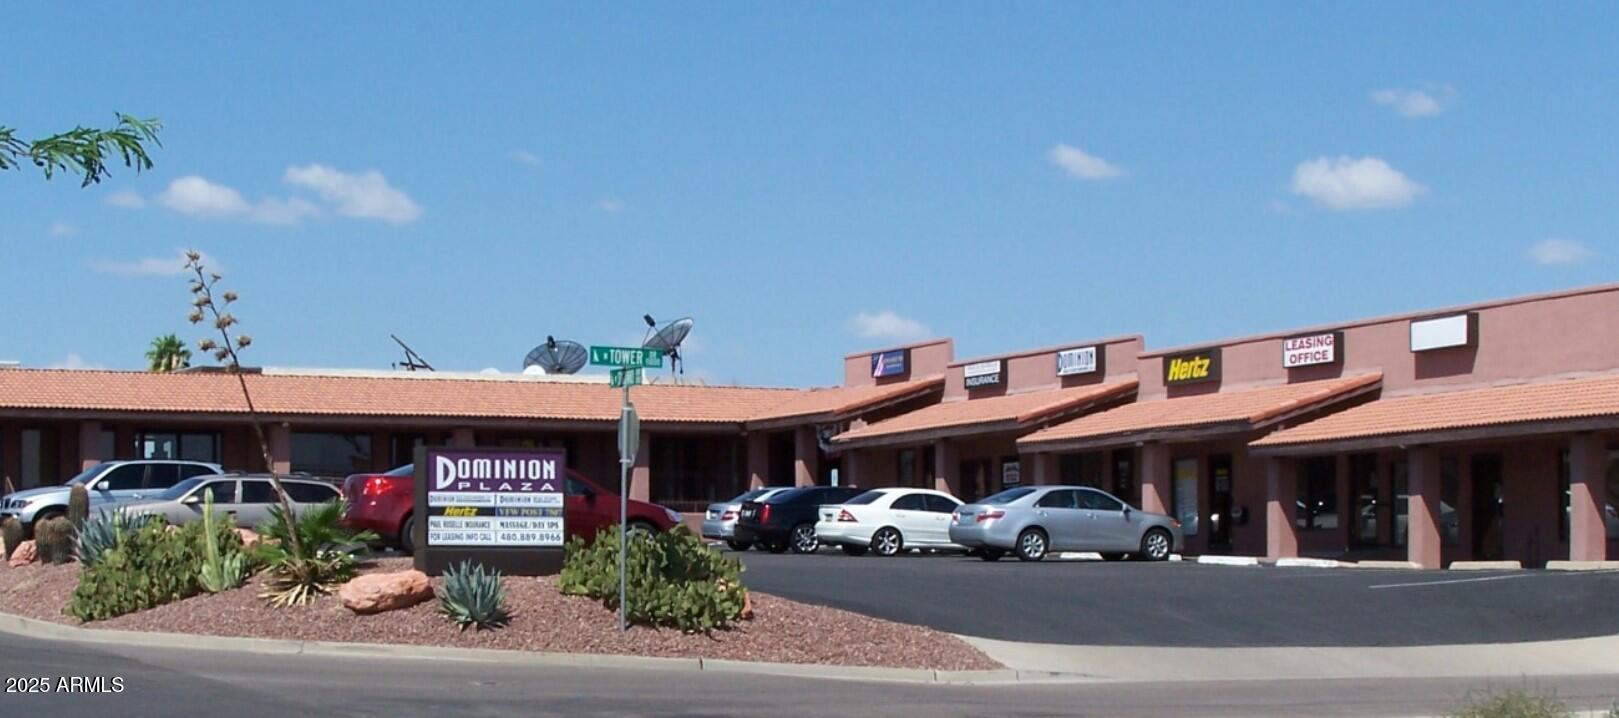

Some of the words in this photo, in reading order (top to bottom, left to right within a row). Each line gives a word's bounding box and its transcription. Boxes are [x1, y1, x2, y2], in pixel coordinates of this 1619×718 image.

[1285, 335, 1333, 351] LEASING
[610, 349, 643, 365] TOWER
[1057, 350, 1093, 373] DOMINION
[1289, 350, 1329, 364] OFFICE
[1168, 357, 1210, 381] Hertz
[966, 374, 999, 386] INSURANCE
[436, 455, 556, 490] DOMINION
[458, 482, 555, 490] PLAZA
[443, 506, 479, 517] Hertz
[465, 520, 491, 529] INSURANCE
[430, 532, 441, 541] FOR
[442, 532, 464, 541] LEASING
[465, 532, 479, 541] INFO
[479, 532, 493, 541] CALL
